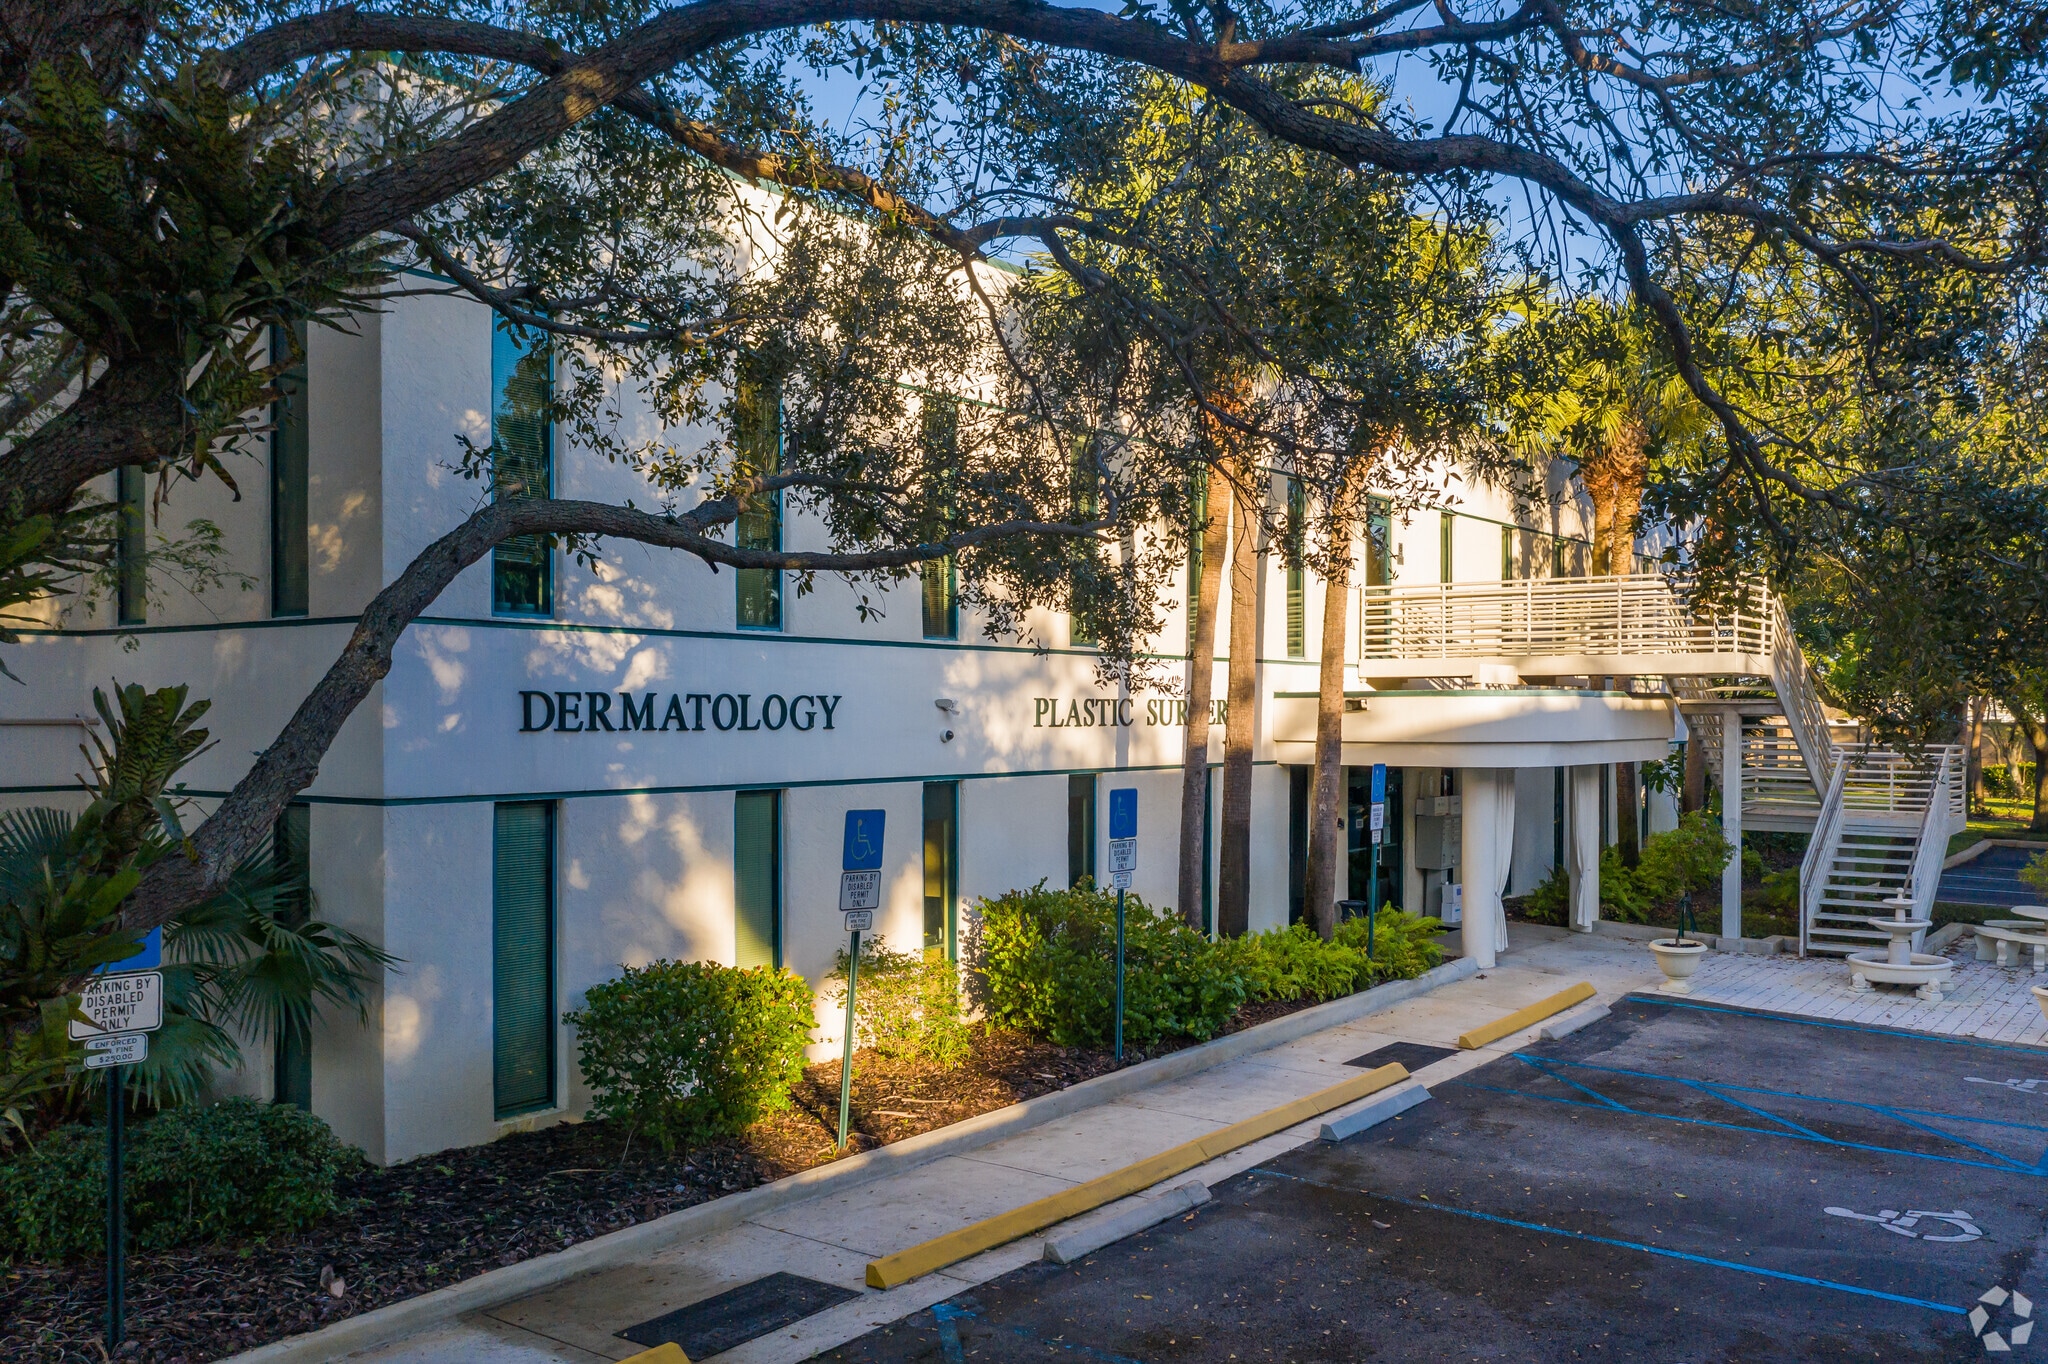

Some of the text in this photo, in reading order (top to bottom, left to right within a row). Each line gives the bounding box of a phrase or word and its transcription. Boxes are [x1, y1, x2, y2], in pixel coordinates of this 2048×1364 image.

[518, 690, 842, 732] DERMATOLOGY
[1033, 697, 1134, 728] PLASTIC
[846, 873, 877, 882] PARKING BY
[848, 882, 873, 891] DISABLED
[850, 891, 869, 899] PERMIT
[852, 899, 866, 907] ONLY
[136, 977, 151, 990] BY
[86, 991, 144, 1008] DISABLED
[94, 1003, 136, 1020] PERMIT
[100, 1016, 130, 1030] ONLY
[95, 1037, 137, 1049] ENFORCED
